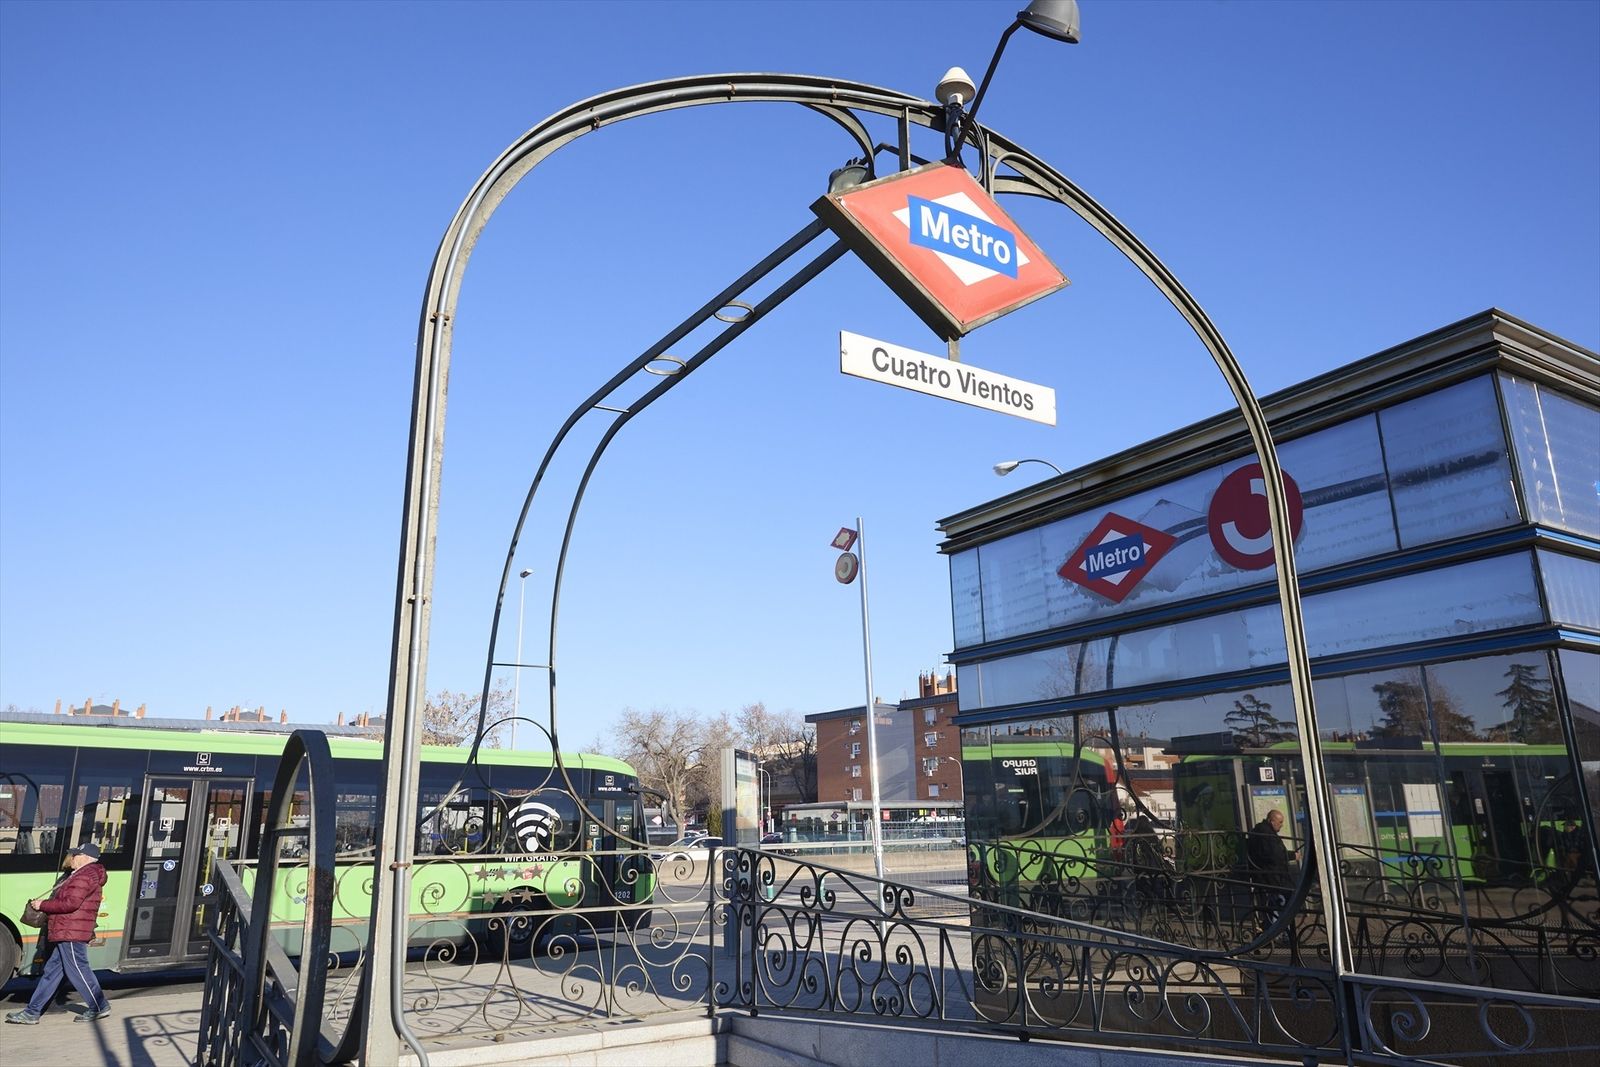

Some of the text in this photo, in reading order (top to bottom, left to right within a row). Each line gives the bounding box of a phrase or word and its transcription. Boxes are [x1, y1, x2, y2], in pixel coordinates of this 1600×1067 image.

[920, 205, 1011, 265] Metro
[872, 347, 1034, 411] Cuatro Vientos
[1088, 545, 1141, 573] Metro
[615, 890, 631, 899] 1202
